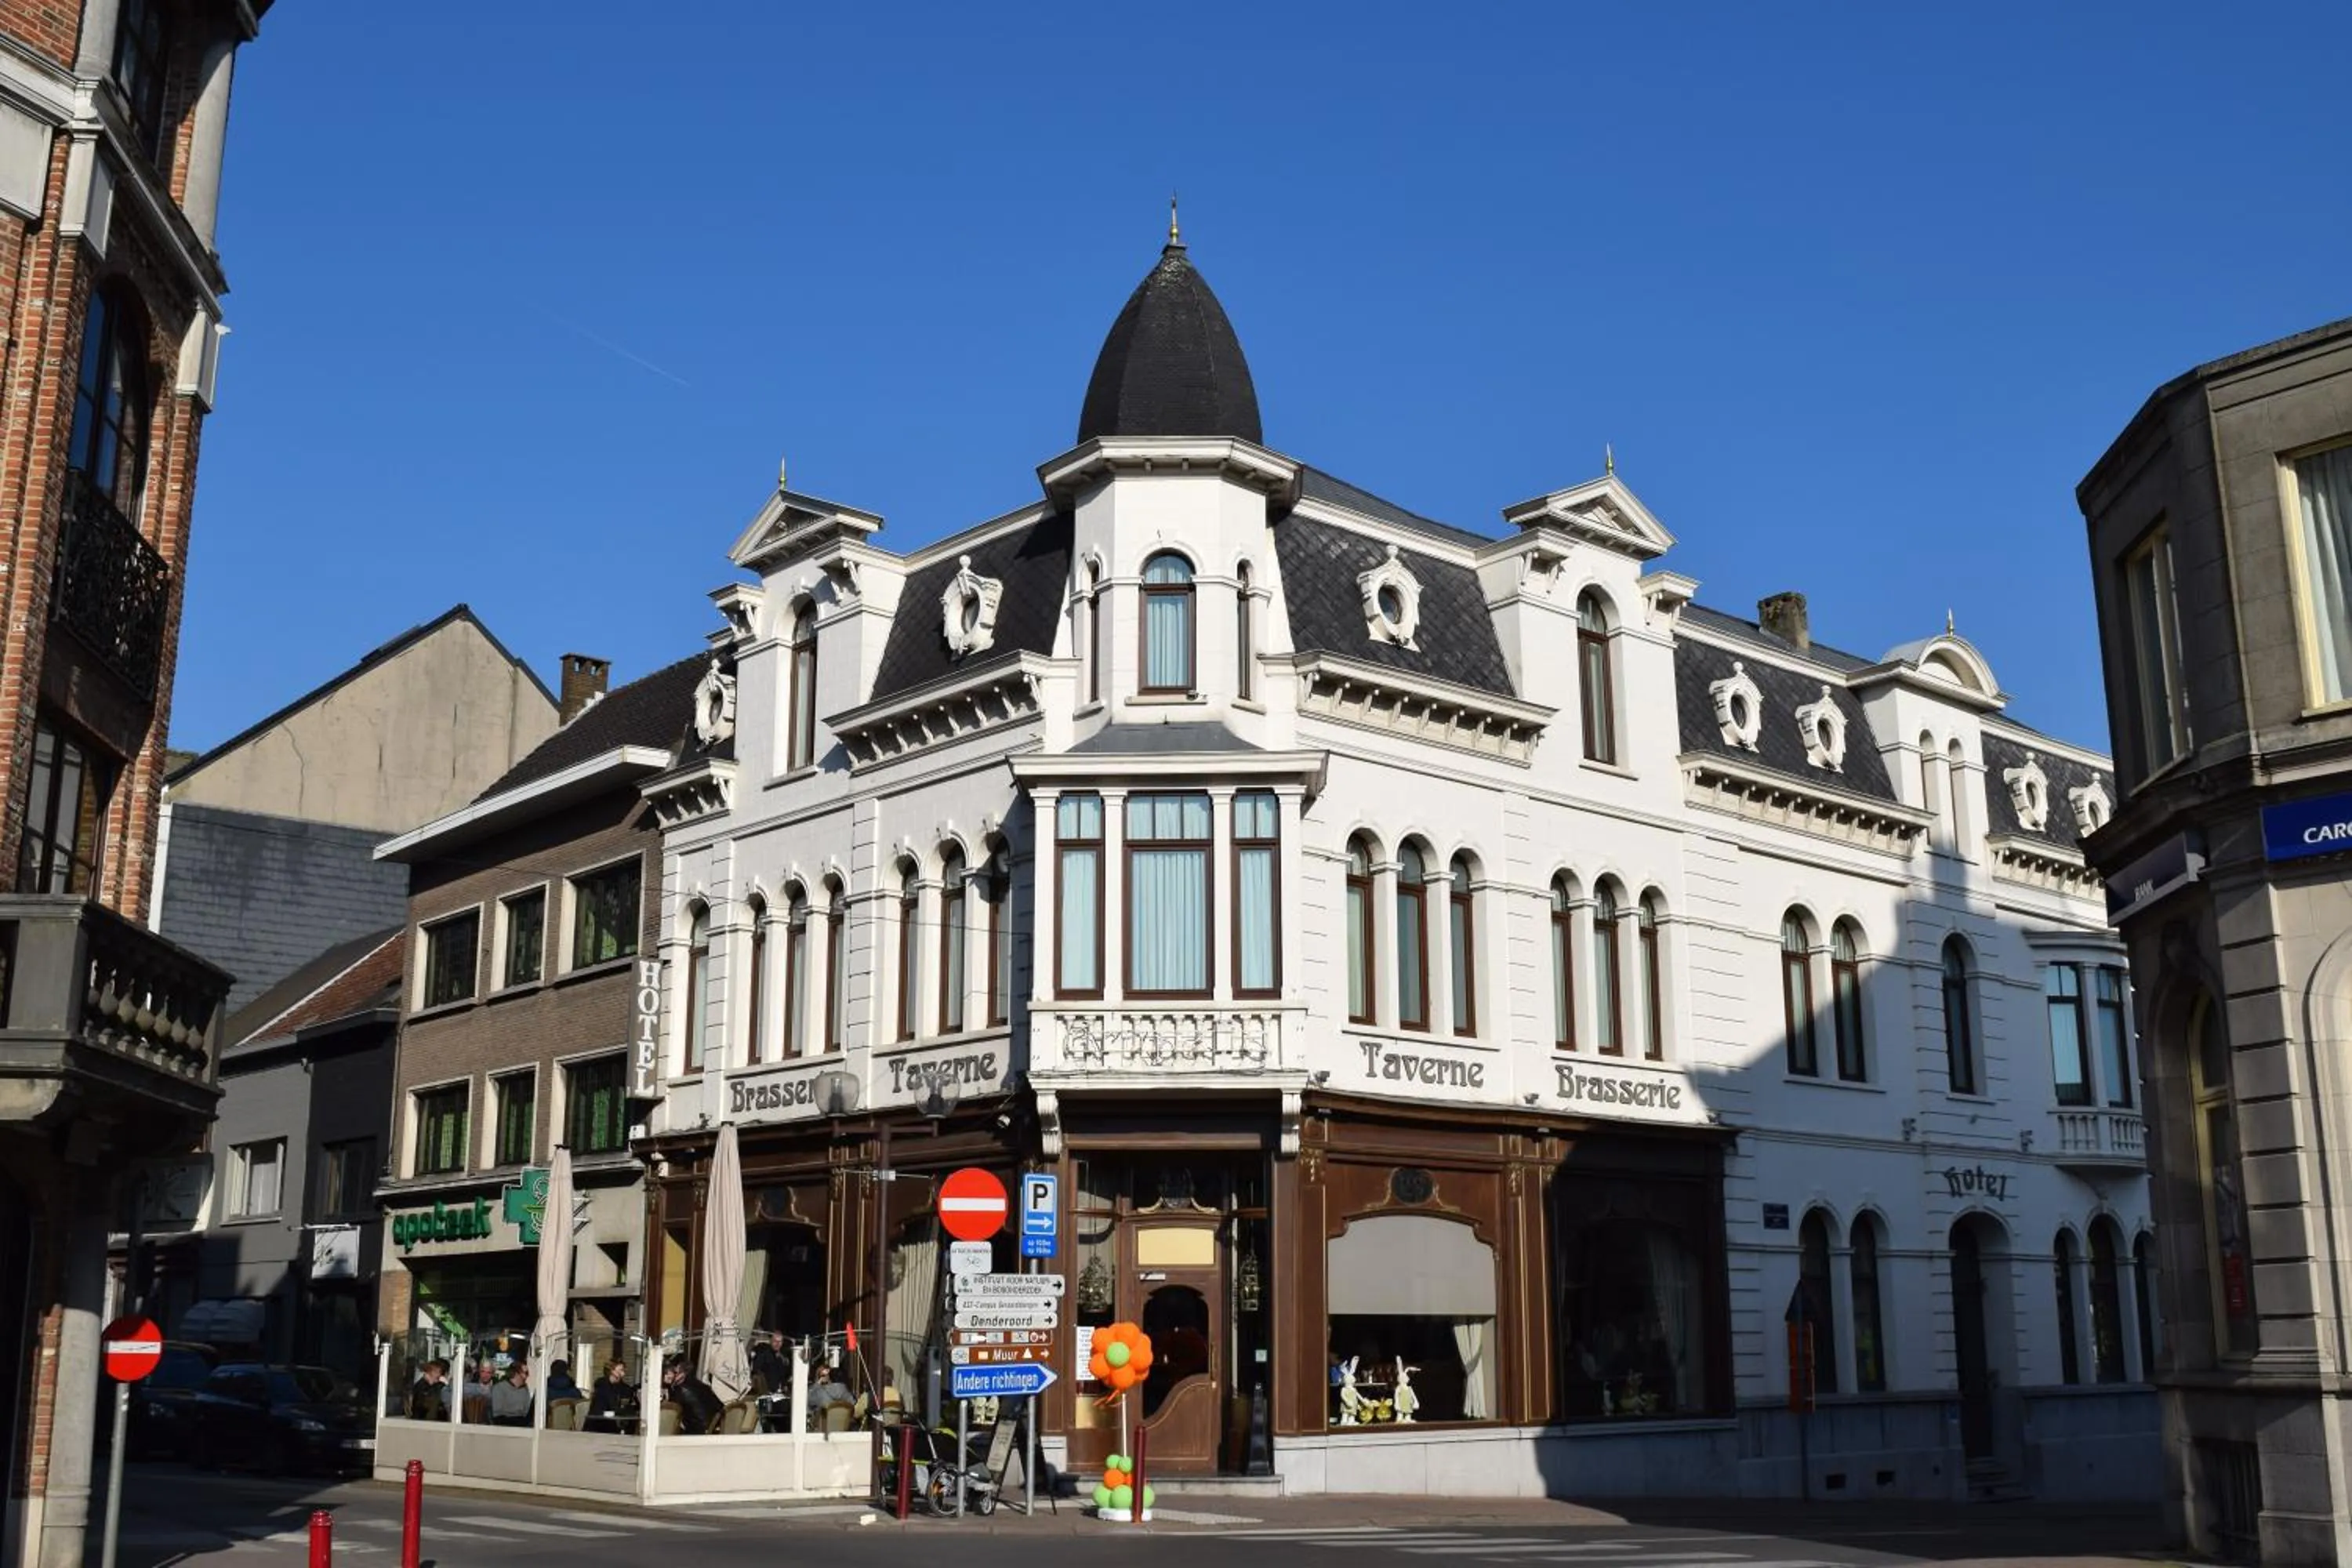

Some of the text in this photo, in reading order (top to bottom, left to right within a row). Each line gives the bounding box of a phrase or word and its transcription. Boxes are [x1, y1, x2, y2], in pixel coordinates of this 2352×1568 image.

[634, 960, 662, 1097] HOTEL
[888, 1051, 997, 1094] Taverne
[1359, 1041, 1484, 1088] Taverne
[730, 1071, 823, 1113] Brasser
[1555, 1064, 1681, 1109] Brasserie
[1033, 1184, 1048, 1210] P
[971, 1315, 1033, 1327] Denderoord
[993, 1348, 1019, 1360] Muur
[956, 1370, 1039, 1391] Andere richtingen
